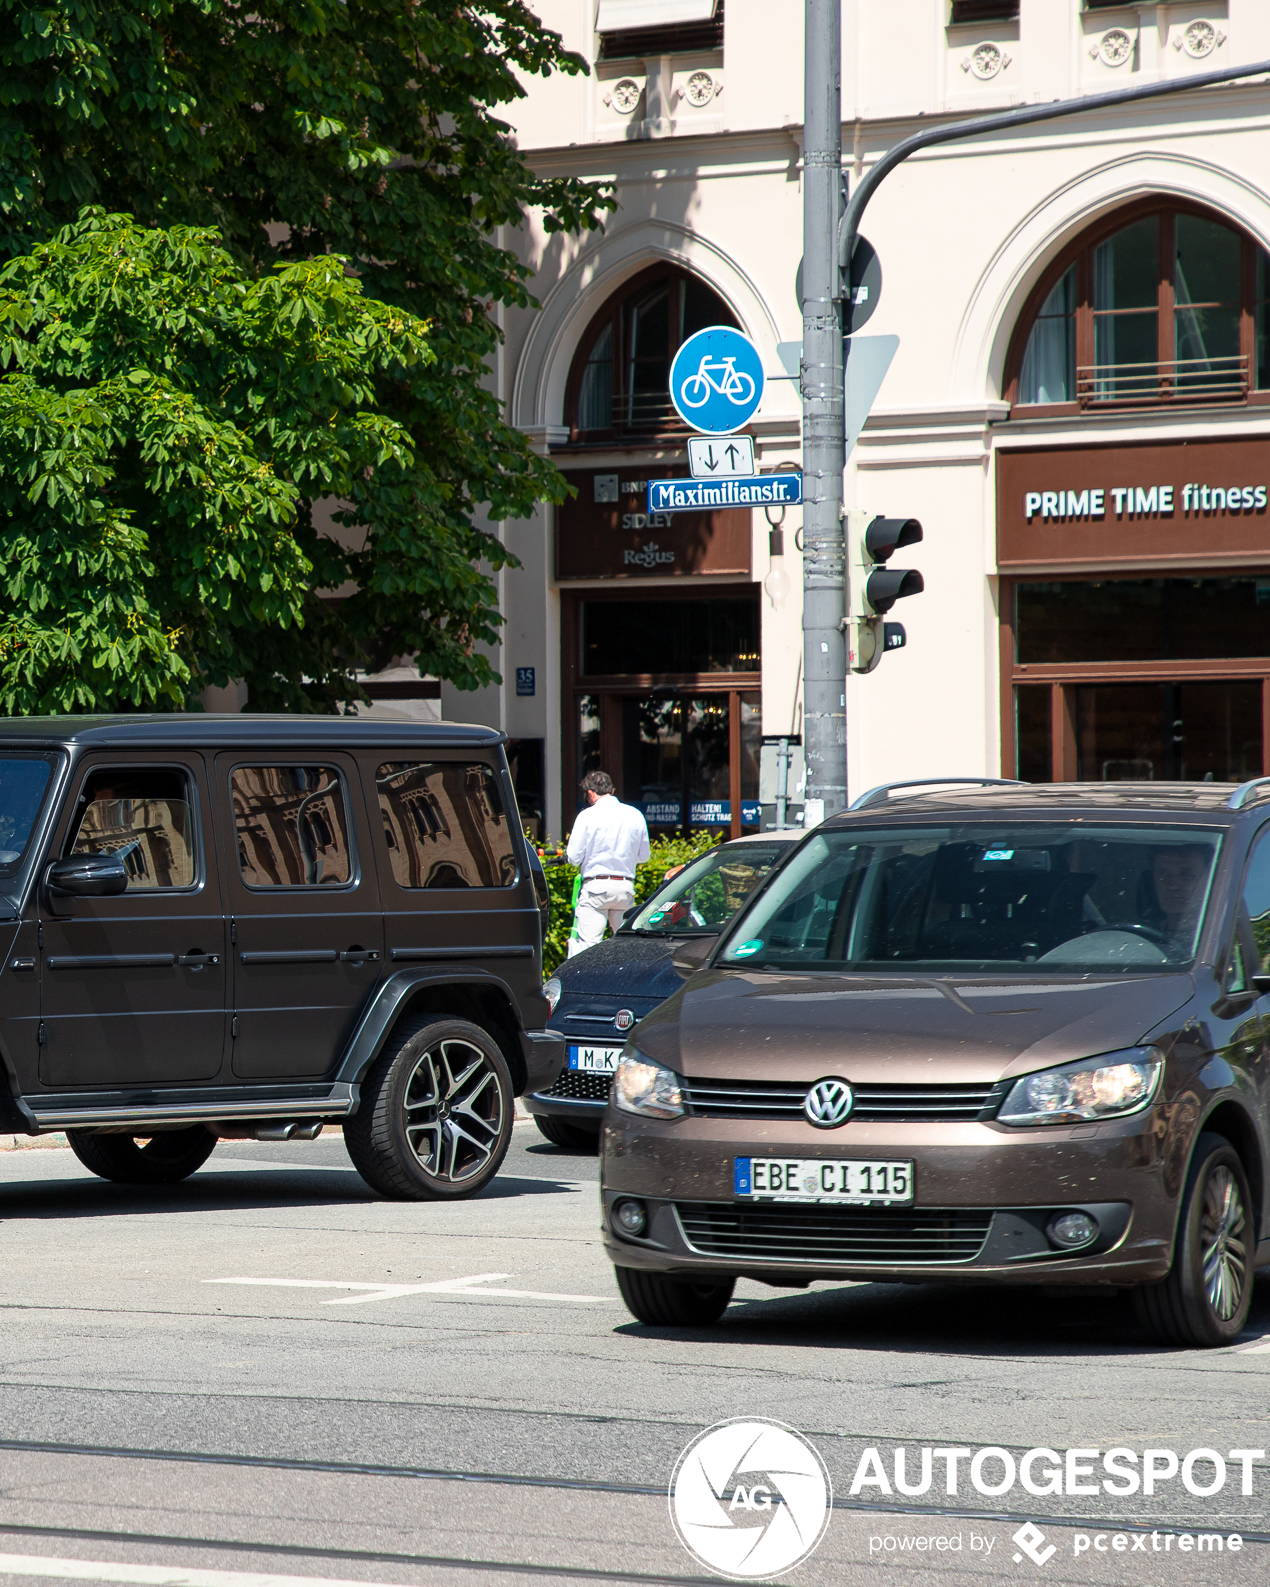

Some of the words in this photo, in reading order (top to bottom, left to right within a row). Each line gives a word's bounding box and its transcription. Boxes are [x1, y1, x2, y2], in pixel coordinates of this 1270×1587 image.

[659, 482, 791, 507] Maximilianstr.
[1025, 489, 1105, 518] PRIME
[1111, 485, 1174, 514] TIME
[1182, 483, 1267, 511] fitness
[622, 513, 674, 529] SIDLEY
[624, 549, 675, 567] Regus
[519, 669, 533, 682] 35
[647, 804, 680, 813] ABSTAND
[691, 803, 722, 813] HALTEN!
[691, 813, 715, 822] SCHUTZ
[618, 1015, 630, 1025] FIAT
[584, 1050, 594, 1067] M
[604, 1051, 615, 1068] K
[753, 1163, 799, 1191] EBE
[821, 1164, 850, 1193] CI
[860, 1166, 907, 1194] 115
